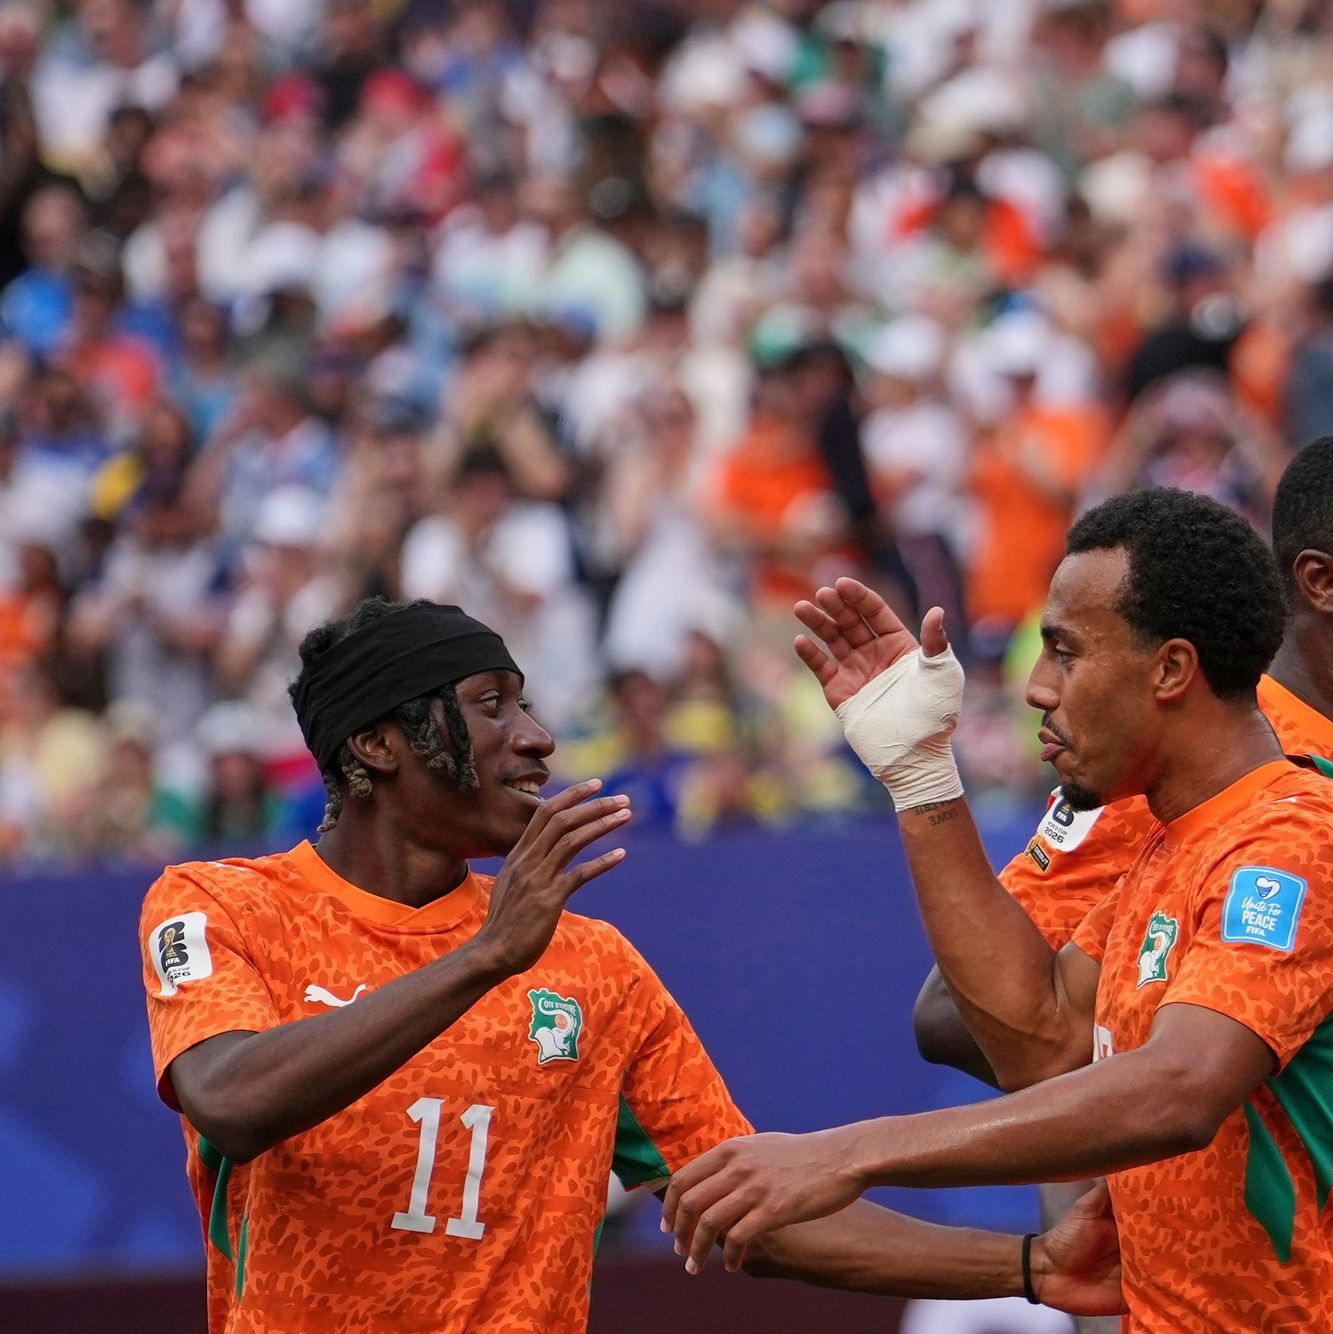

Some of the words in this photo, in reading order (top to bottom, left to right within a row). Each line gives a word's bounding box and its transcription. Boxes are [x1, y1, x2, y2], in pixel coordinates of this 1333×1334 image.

[1044, 827, 1065, 844] 2026
[1241, 896, 1267, 912] Unite
[1267, 903, 1282, 916] For
[1241, 910, 1278, 932] PEACE
[1245, 926, 1266, 937] FIFA
[390, 1096, 496, 1241] 11
